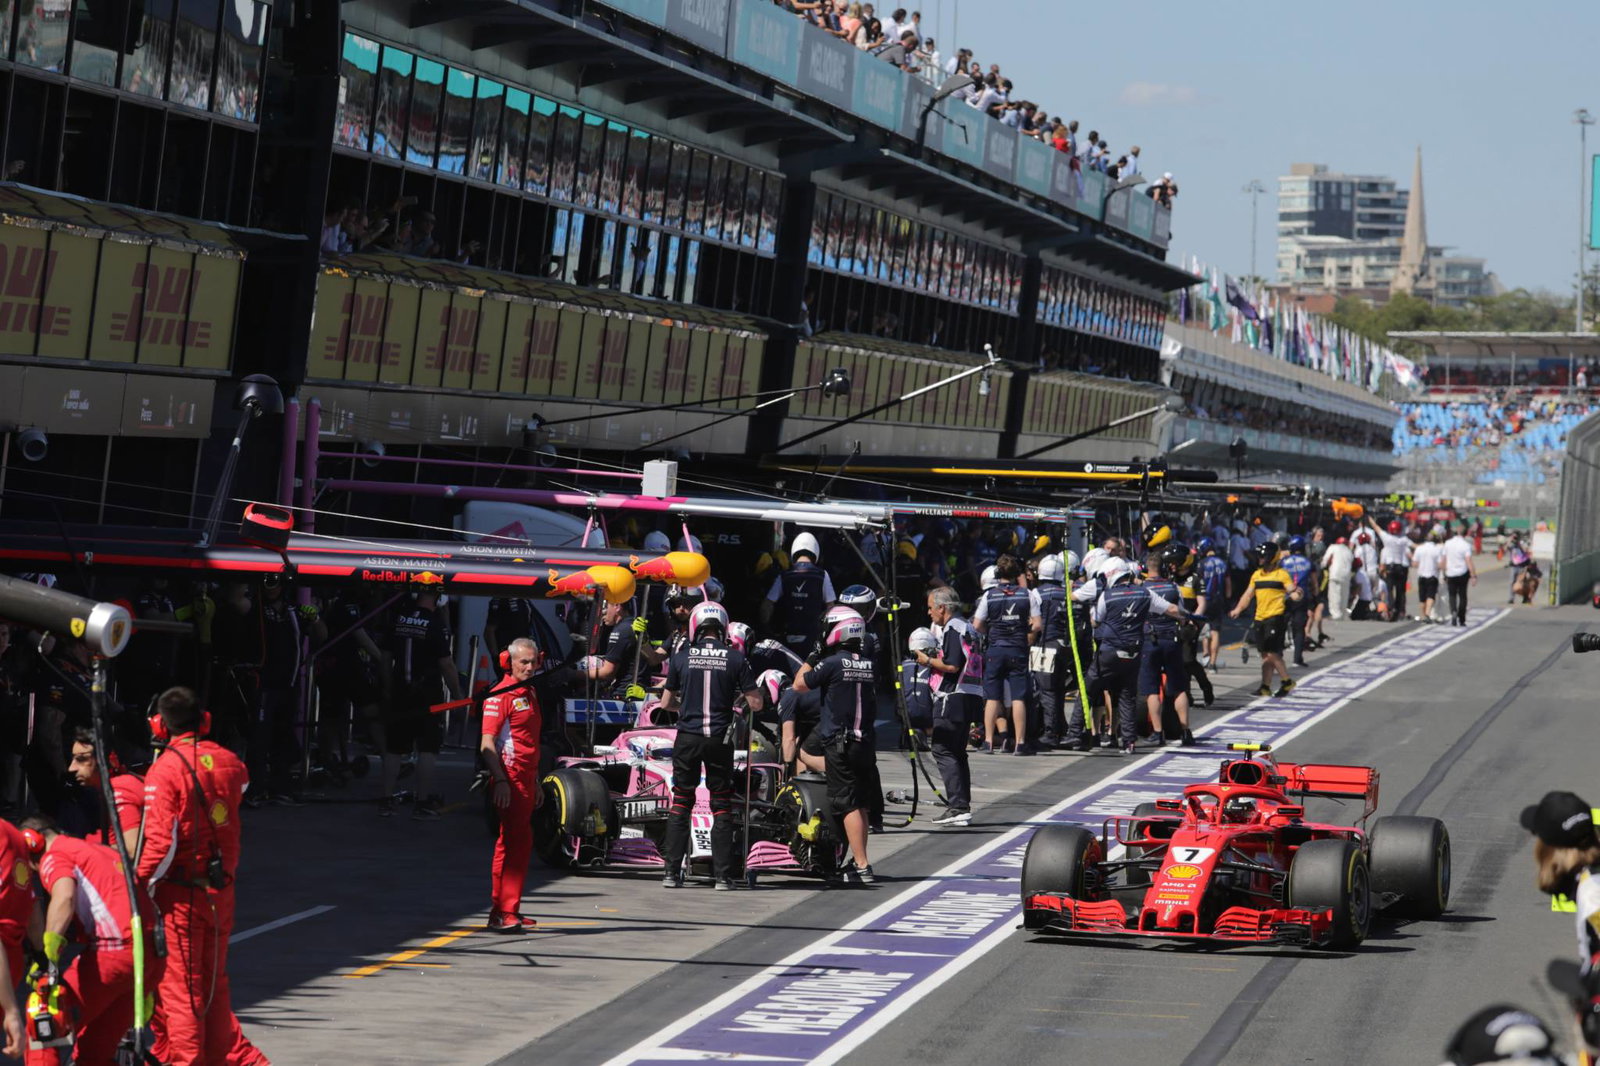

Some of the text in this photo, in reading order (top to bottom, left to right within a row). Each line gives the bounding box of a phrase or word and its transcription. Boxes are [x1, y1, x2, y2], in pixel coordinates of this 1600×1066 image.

[914, 508, 953, 517] WILLIAMS
[989, 511, 1020, 521] RACING
[459, 545, 537, 556] ASTON MARTIN
[363, 557, 447, 569] ASTON MARTIN
[700, 648, 728, 658] BWT
[688, 658, 727, 667] MAGNESIUM
[851, 660, 873, 670] BWT
[1184, 848, 1200, 862] 7
[718, 967, 915, 1036] MELBOURNE
